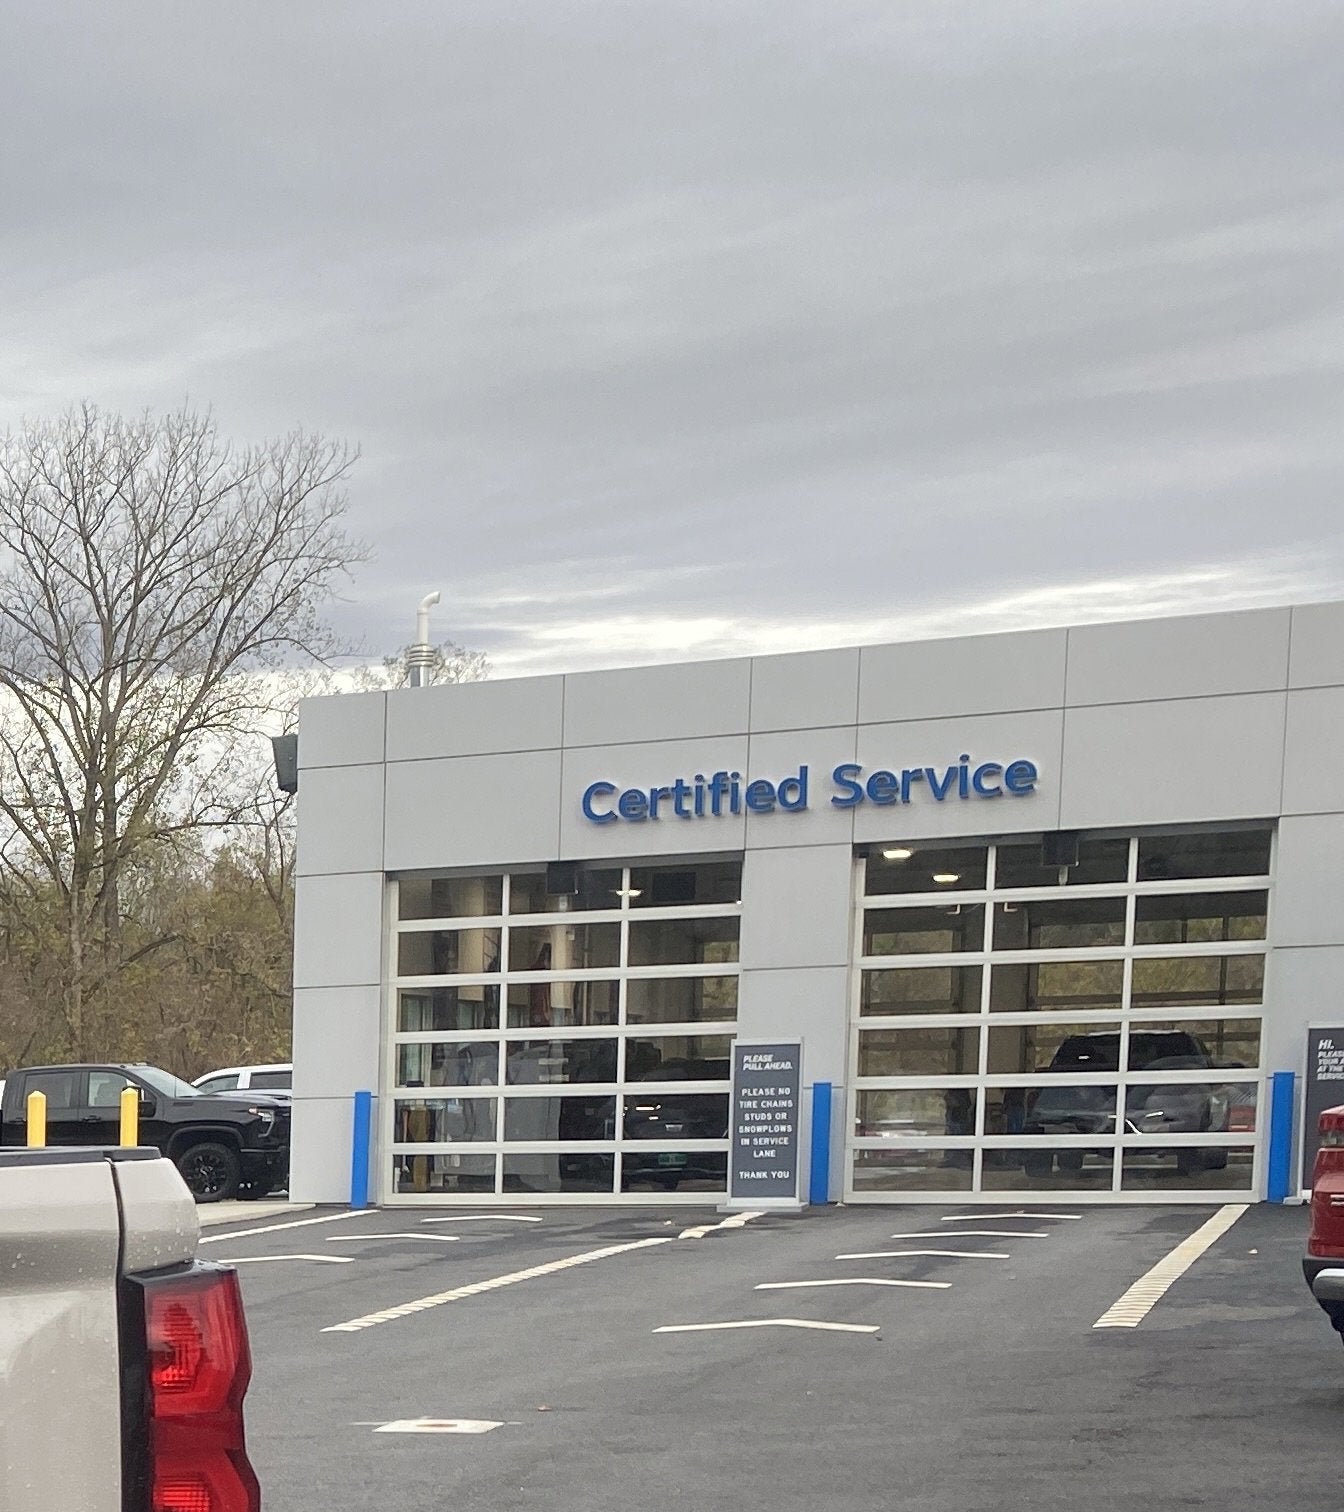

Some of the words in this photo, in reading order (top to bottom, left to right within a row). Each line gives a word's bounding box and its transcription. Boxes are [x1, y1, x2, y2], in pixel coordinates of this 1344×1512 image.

[582, 764, 809, 823] Certified
[831, 754, 1037, 808] Service
[1318, 1039, 1334, 1050] HI.
[743, 1055, 773, 1063] PLEASE
[742, 1062, 763, 1071] PULL
[741, 1088, 775, 1097] PLEASE
[778, 1087, 791, 1095] NO
[739, 1100, 758, 1108] TIRE
[761, 1100, 793, 1108] CHAINS
[744, 1112, 772, 1120] STUDS
[775, 1112, 787, 1120] OR
[738, 1124, 793, 1133] SNOWPLOWS
[740, 1138, 750, 1146] IN
[752, 1137, 789, 1146] SERVICE
[753, 1150, 776, 1158] LANE
[739, 1171, 768, 1179] THANK
[771, 1171, 790, 1179] YOU
